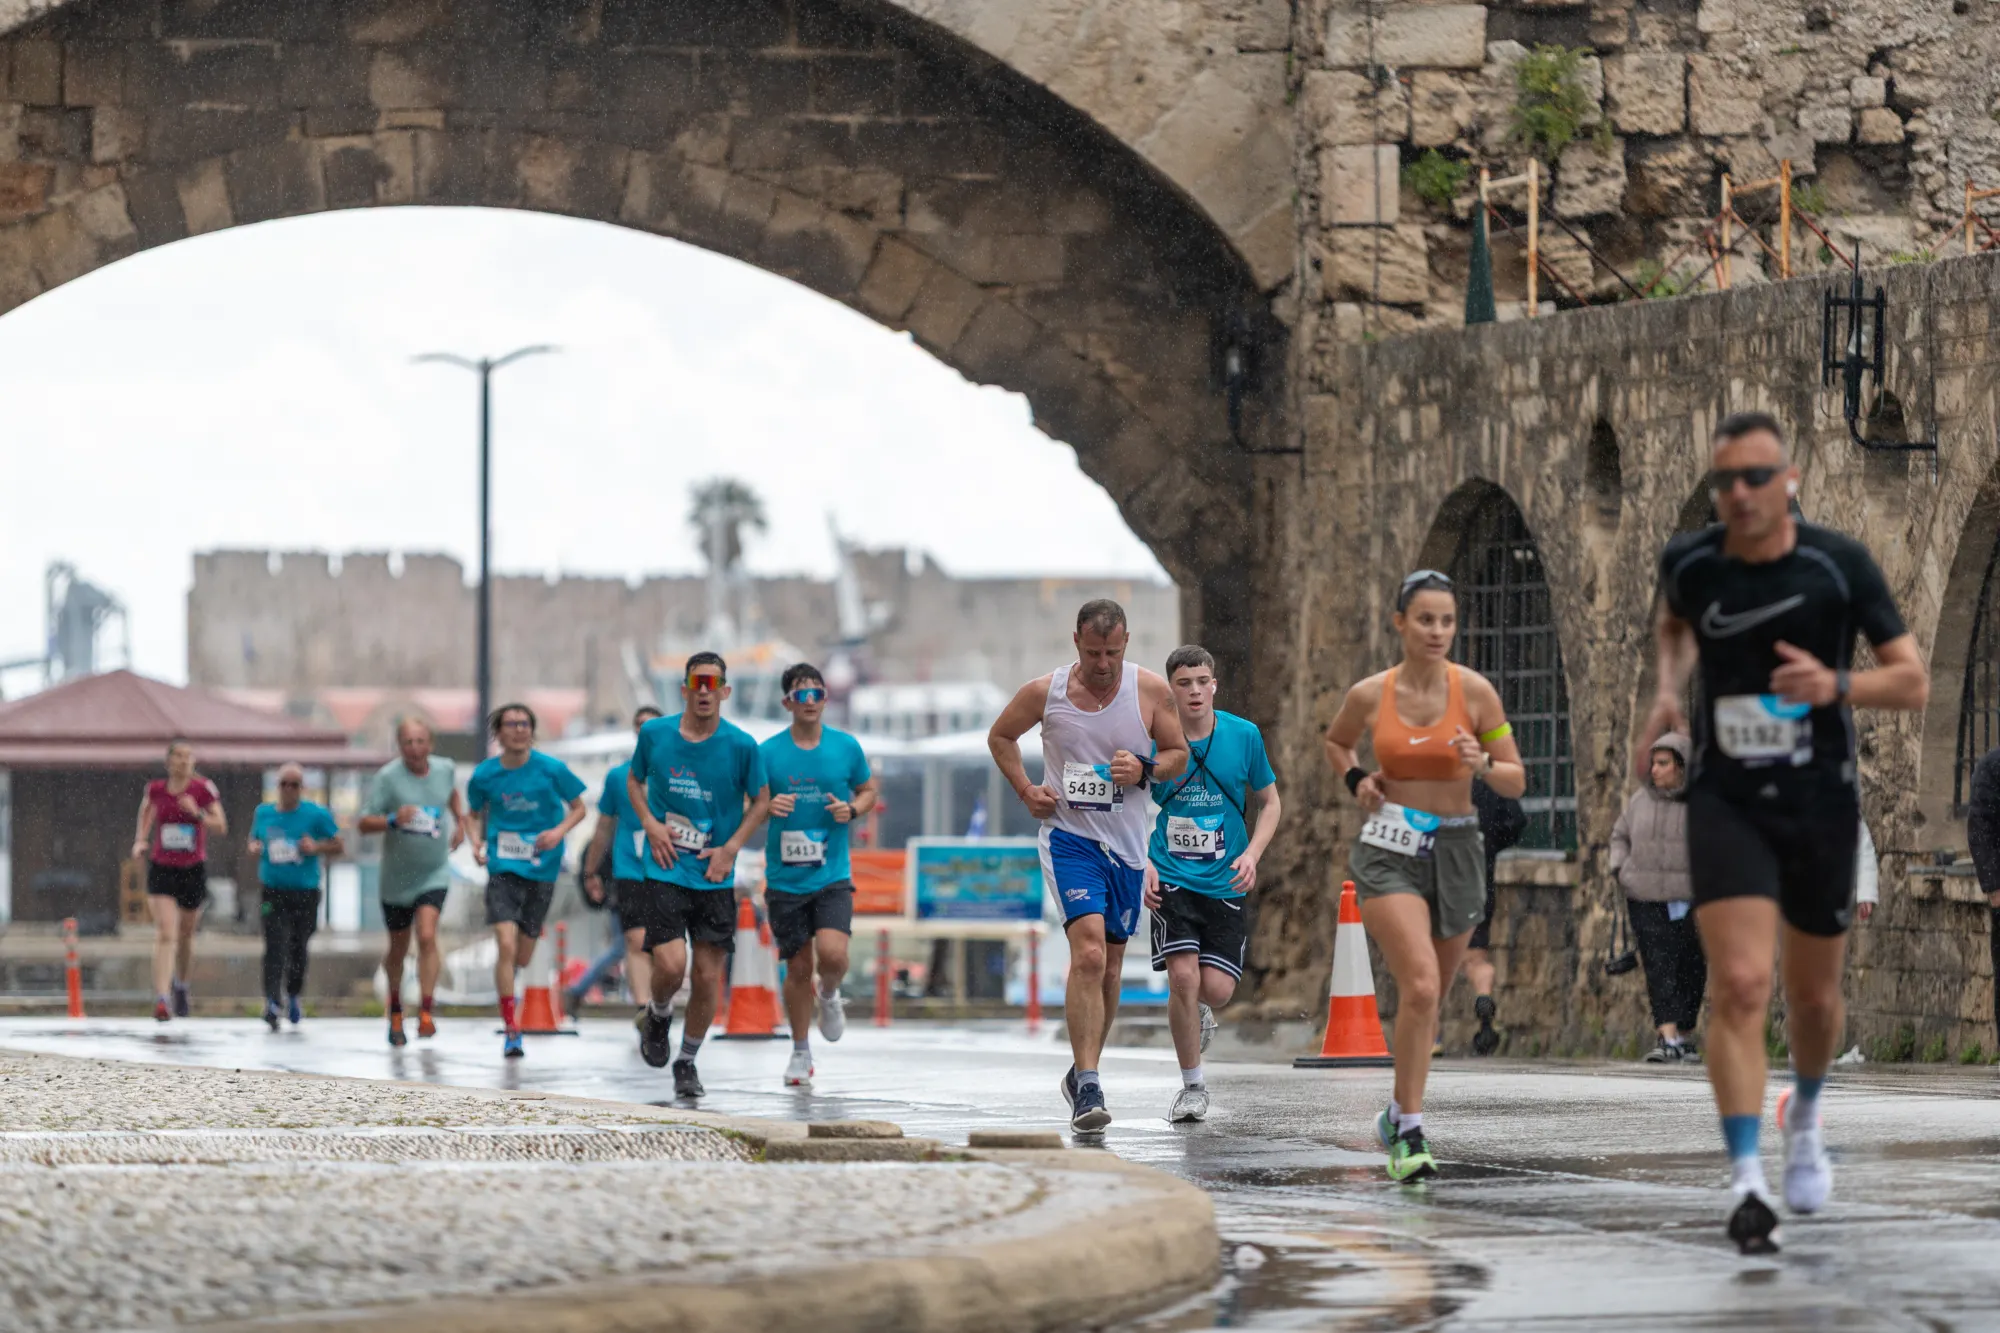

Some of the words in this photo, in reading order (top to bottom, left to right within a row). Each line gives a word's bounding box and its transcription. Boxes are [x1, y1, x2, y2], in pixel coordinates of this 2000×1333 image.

[1068, 781, 1106, 796] 5433
[1174, 834, 1209, 847] 5617
[787, 844, 817, 857] 5413
